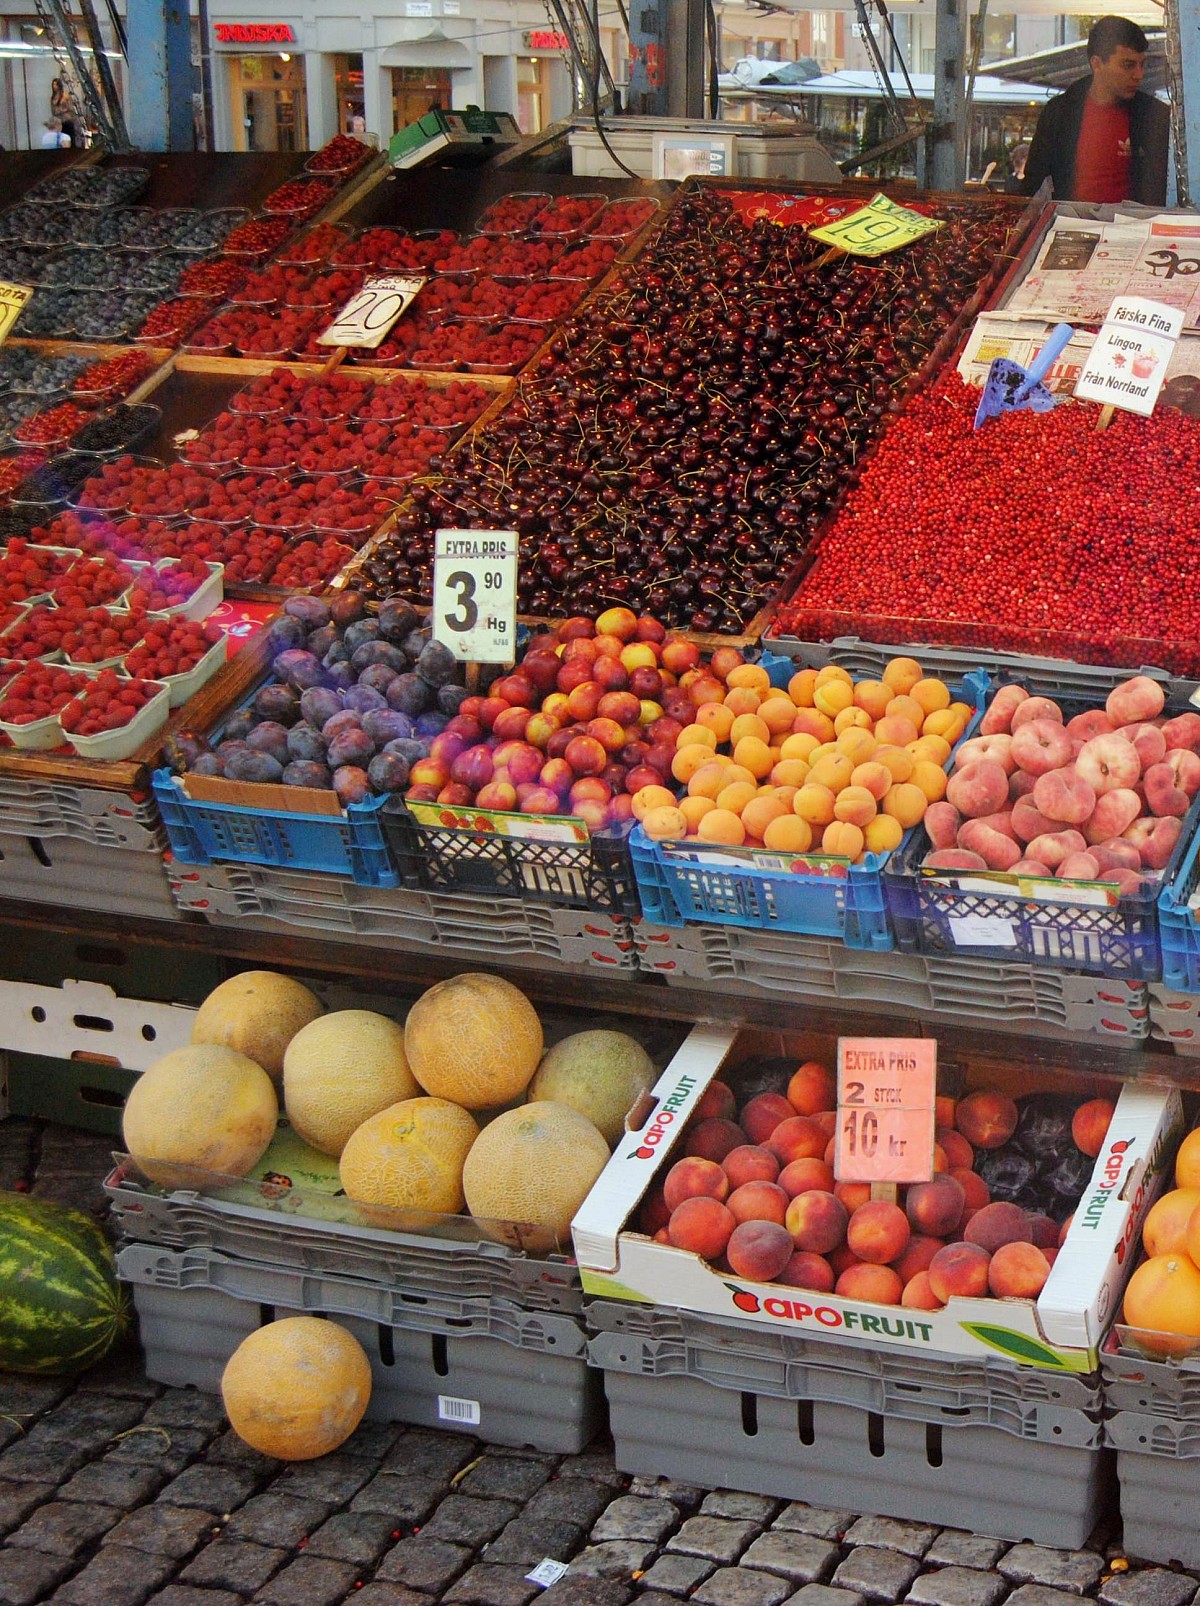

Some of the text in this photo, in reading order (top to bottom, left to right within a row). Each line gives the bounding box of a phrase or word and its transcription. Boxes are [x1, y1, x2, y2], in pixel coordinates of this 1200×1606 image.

[825, 216, 900, 244] 19
[333, 292, 404, 329] 20
[1114, 307, 1172, 332] Färska Fina
[1108, 335, 1142, 352] Lingon
[1083, 371, 1104, 386] Från
[1105, 376, 1149, 397] Norrland
[446, 541, 506, 559] EXTRA PRIS
[444, 571, 503, 632] 3 90
[487, 617, 507, 632] Hg
[845, 1050, 916, 1072] EXTRA PRIS
[845, 1081, 902, 1104] 2 STYCK
[844, 1110, 907, 1158] 10 kr
